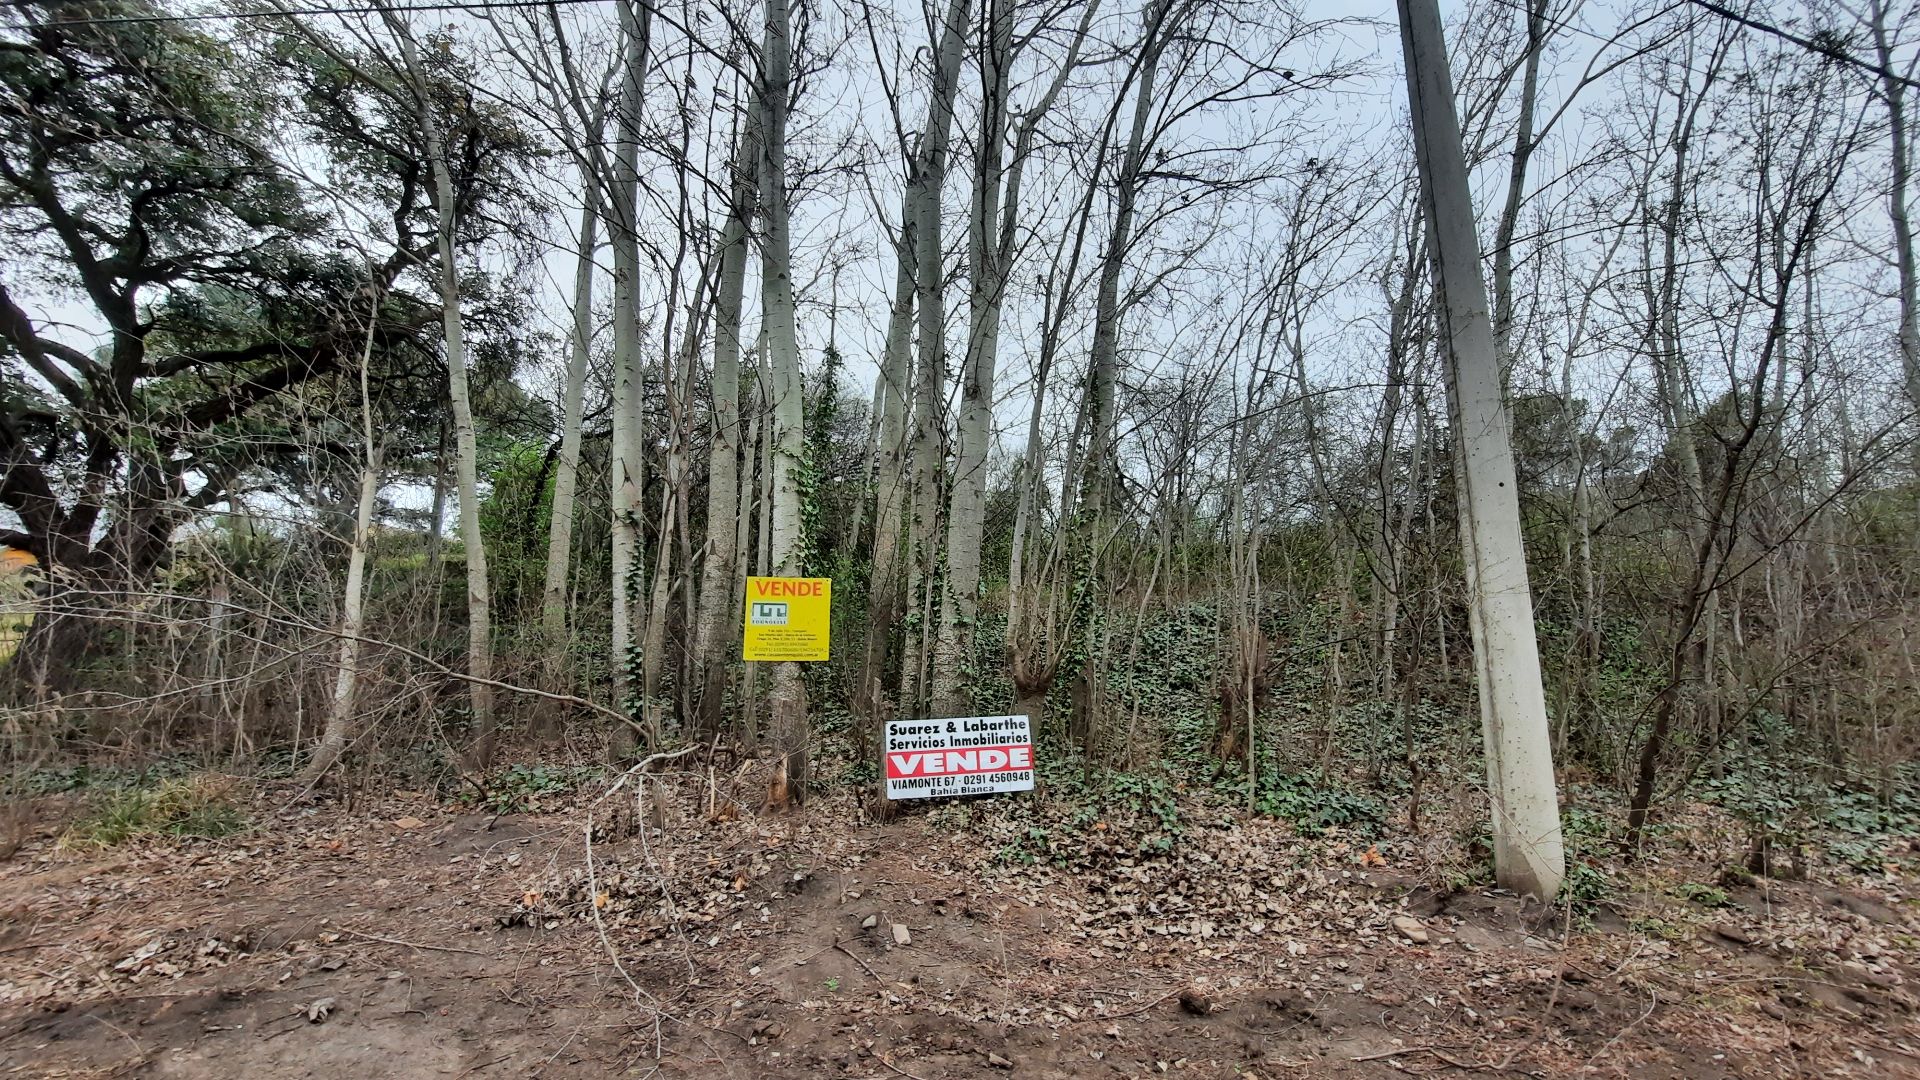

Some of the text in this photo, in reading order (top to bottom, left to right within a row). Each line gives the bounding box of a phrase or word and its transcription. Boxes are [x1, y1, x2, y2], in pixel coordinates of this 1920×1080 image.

[755, 580, 823, 597] VENDE
[889, 717, 1026, 736] Suarez & Labarthe
[889, 732, 1028, 750] Servicios Inmobiliarios
[890, 747, 1031, 775] VENDE
[892, 777, 942, 790] VIAMONTE
[944, 776, 955, 787] 67
[963, 774, 986, 786] 0291
[989, 771, 1030, 784] 4560948
[961, 785, 994, 794] Blanca
